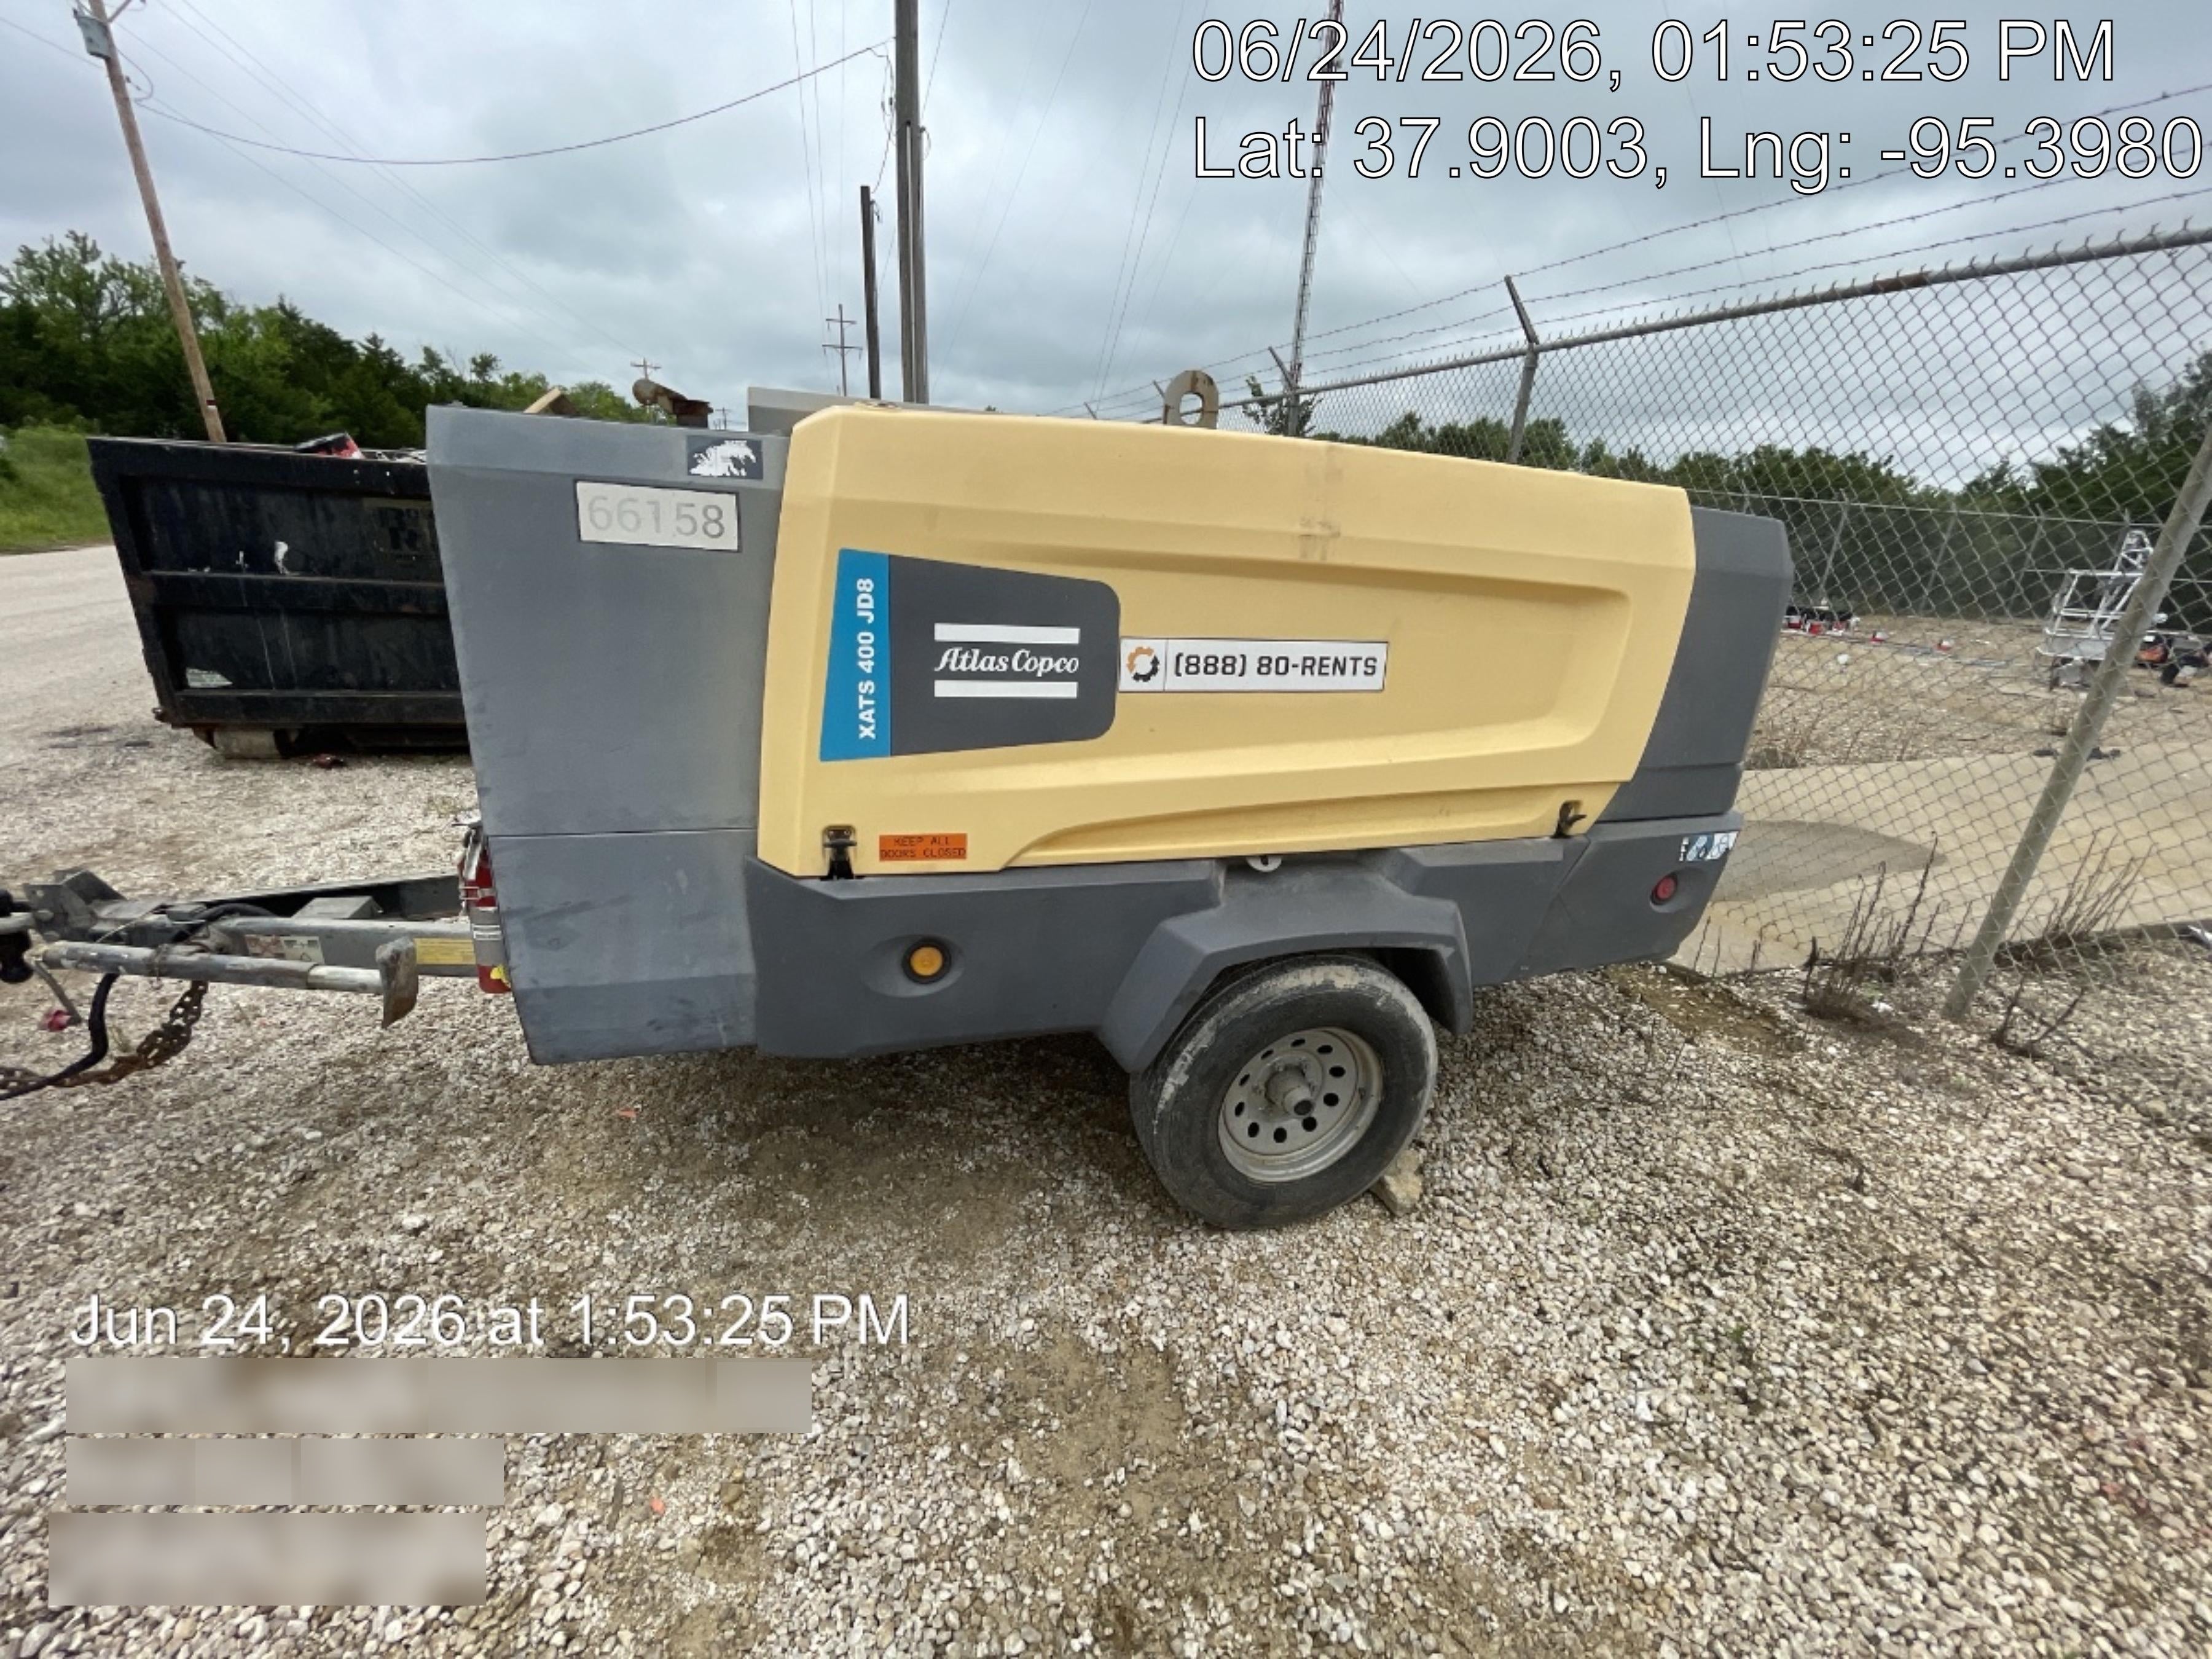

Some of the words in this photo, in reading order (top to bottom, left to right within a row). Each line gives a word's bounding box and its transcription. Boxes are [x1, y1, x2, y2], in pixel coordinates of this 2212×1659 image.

[588, 495, 725, 539] 66158
[856, 578, 874, 624] JD8
[857, 631, 875, 673] 400
[934, 646, 1009, 672] Atlas
[1011, 649, 1080, 677] Copco
[1174, 652, 1246, 677] (888)
[1256, 656, 1378, 677] 80-RENTS
[858, 680, 876, 740] XATS
[880, 849, 916, 858] DOORS
[923, 847, 967, 858] CLOSED
[893, 836, 924, 847] KEEP
[930, 836, 949, 845] ALL
